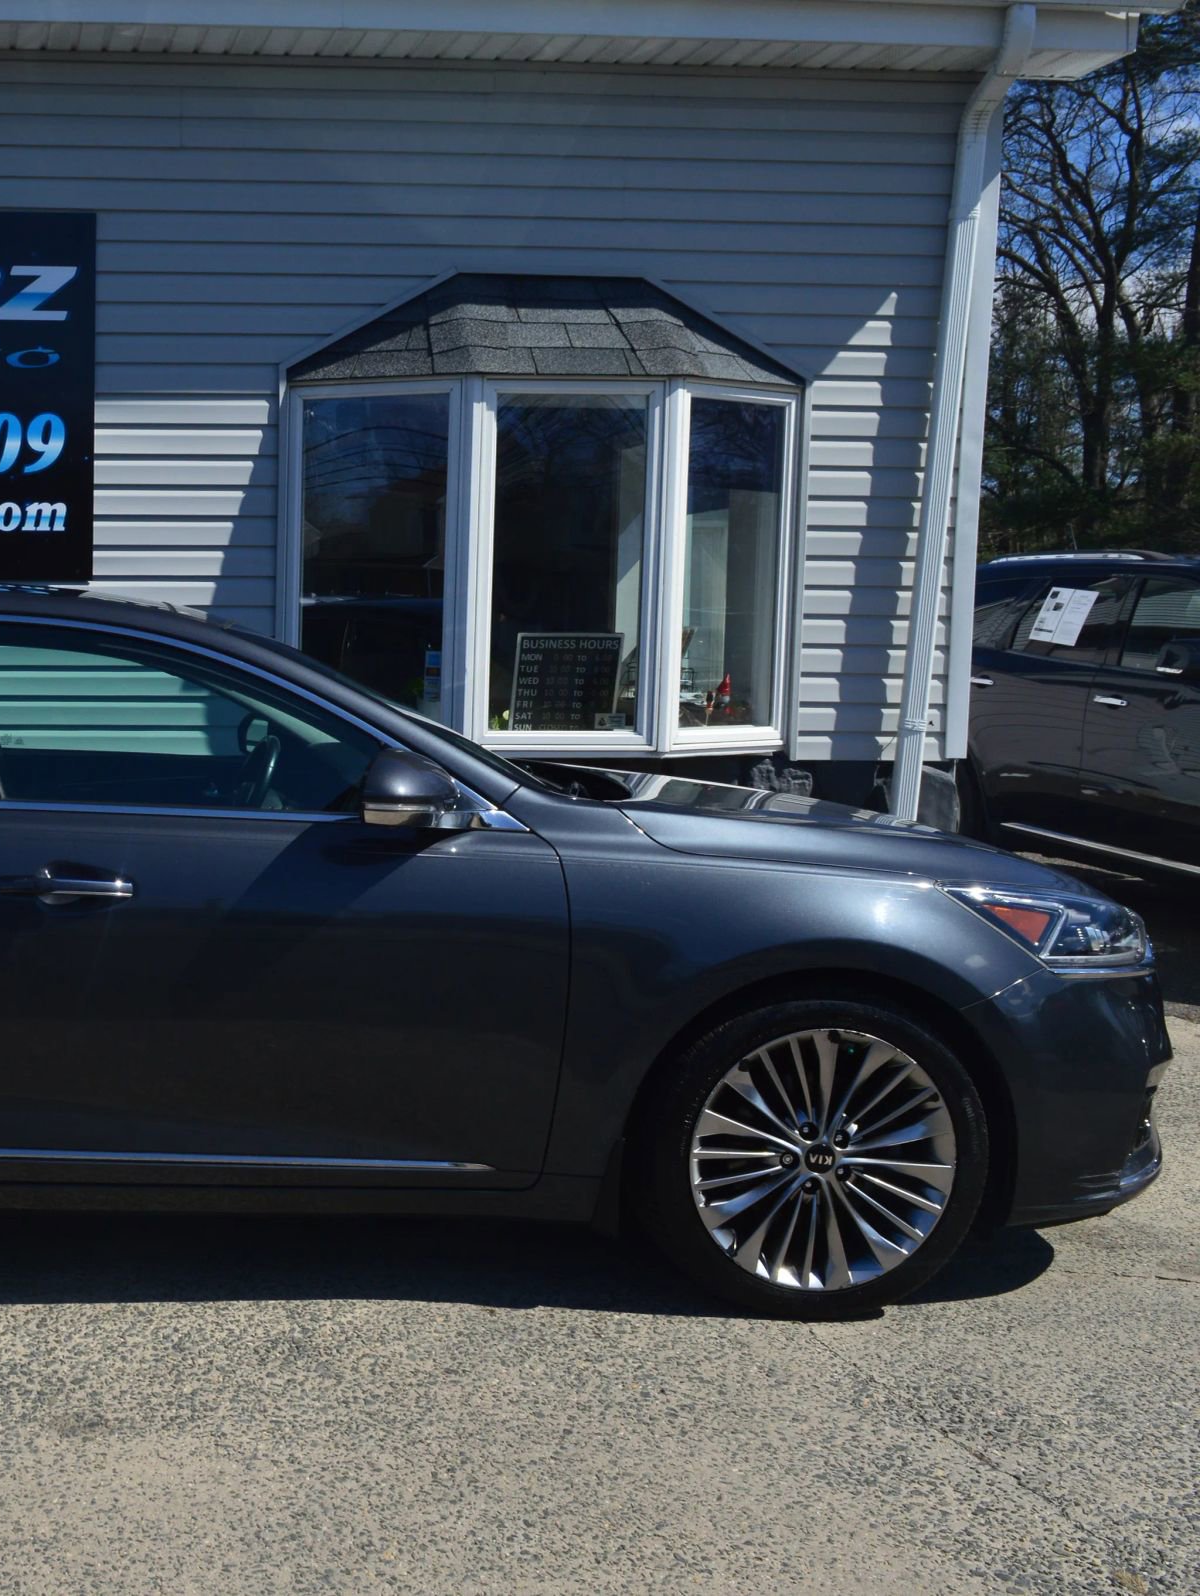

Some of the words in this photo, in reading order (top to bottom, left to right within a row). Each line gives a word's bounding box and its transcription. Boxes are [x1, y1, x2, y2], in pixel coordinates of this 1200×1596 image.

[523, 640, 576, 649] BUSINESS
[579, 640, 619, 649] HOURS
[809, 1153, 833, 1166] KIA
